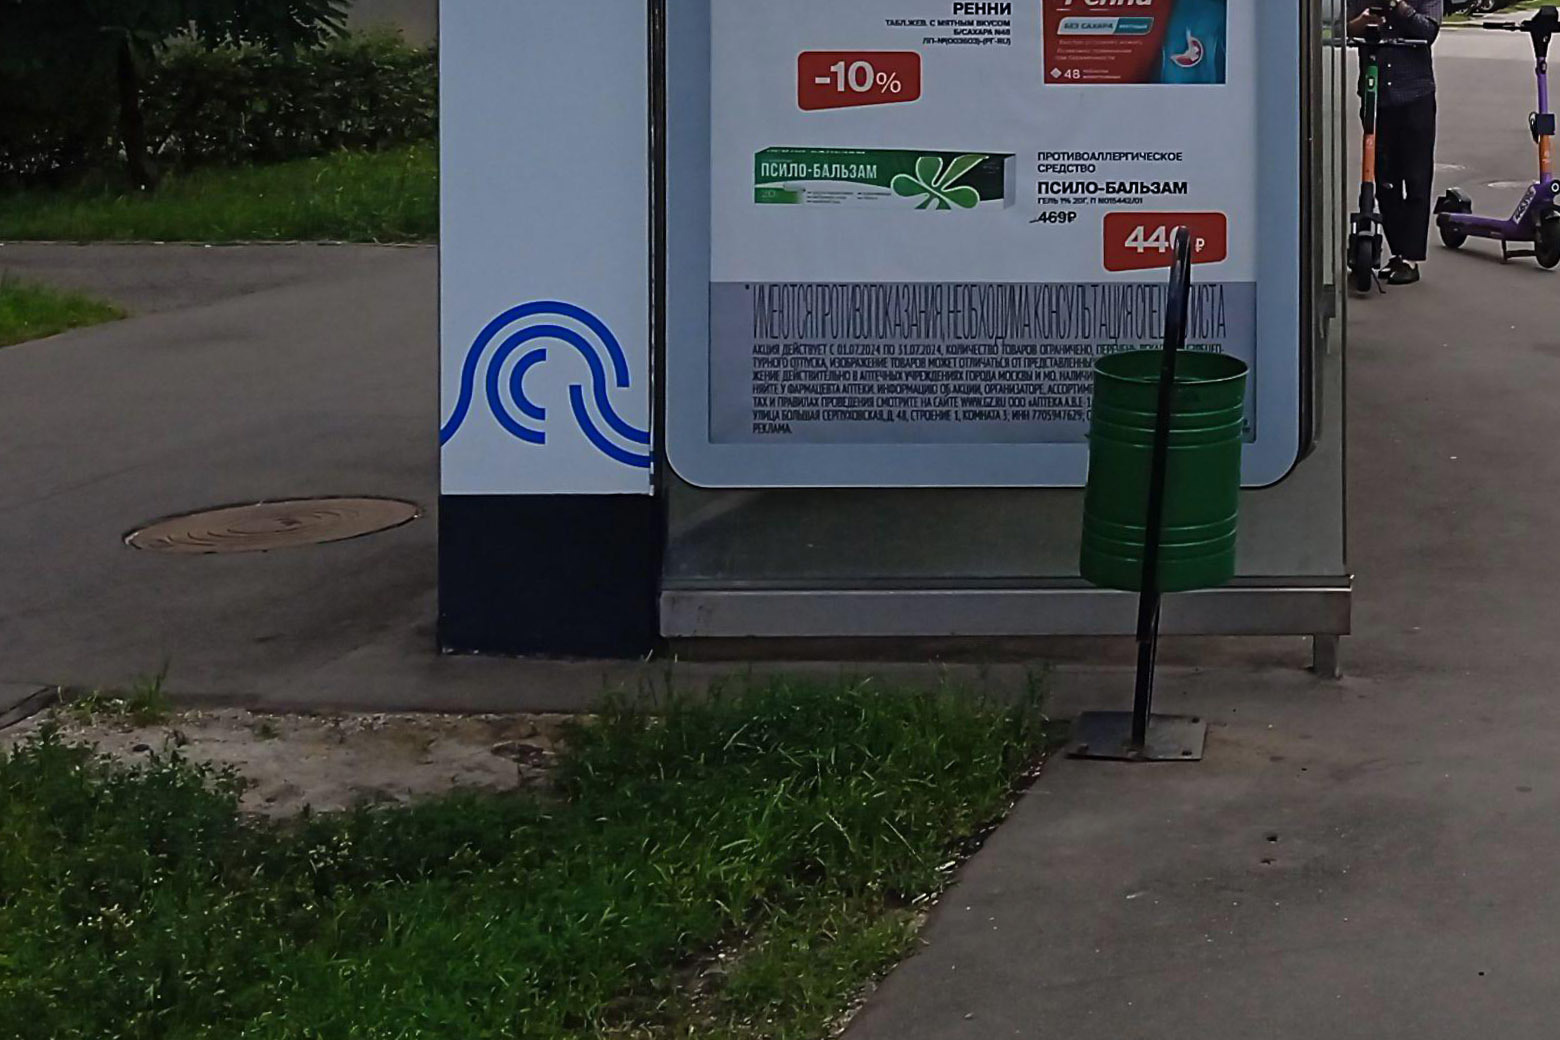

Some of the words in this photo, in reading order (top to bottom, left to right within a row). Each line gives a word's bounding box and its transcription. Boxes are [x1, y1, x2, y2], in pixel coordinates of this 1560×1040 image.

[953, 2, 1012, 15] РЕННИ
[815, 61, 901, 94] -10%
[1064, 69, 1080, 79] 48
[1037, 151, 1183, 161] ПРОТИВОАЛЛЕРГИЧЕСКОЕ
[761, 162, 877, 179] ПСИЛО-БАЛЬЗАМ
[1037, 164, 1096, 174] СРЕДСТВО
[1037, 181, 1188, 195] ПСИЛО-БАЛЬЗАМ
[752, 344, 780, 356] АКЦИЯ
[782, 342, 826, 356] ДЕЙСТВУЕТ
[837, 344, 881, 356] 01.07.2024
[946, 344, 999, 356] КОЛИЧЕСТВО
[1001, 344, 1037, 356] ТОВАРОВ
[891, 357, 925, 369] ТОВАРОВ
